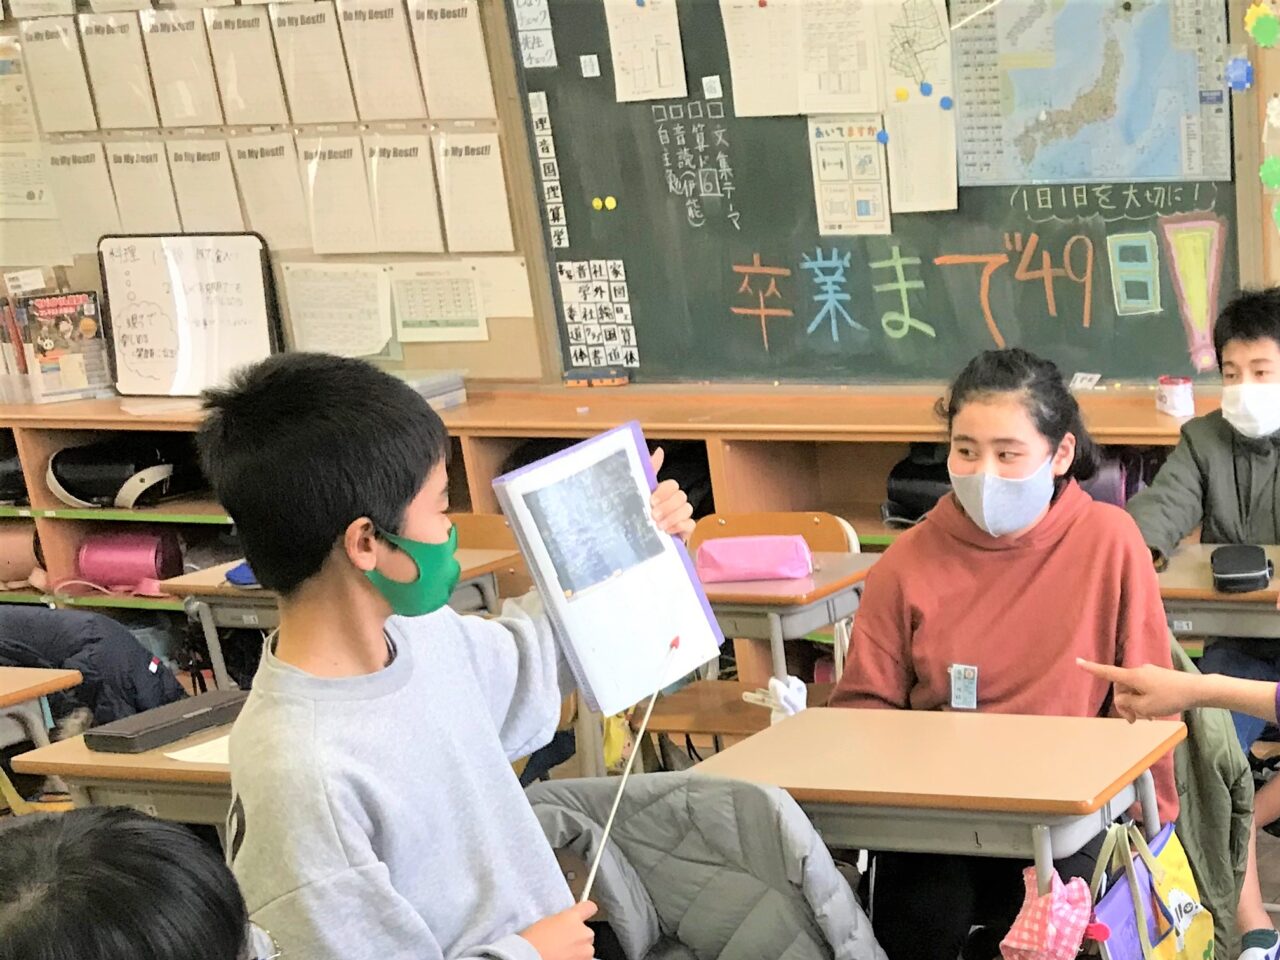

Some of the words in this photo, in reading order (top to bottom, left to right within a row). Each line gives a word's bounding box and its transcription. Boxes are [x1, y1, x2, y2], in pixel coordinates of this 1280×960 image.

[464, 144, 491, 156] Best!!
[713, 123, 741, 231] 文集テーマ
